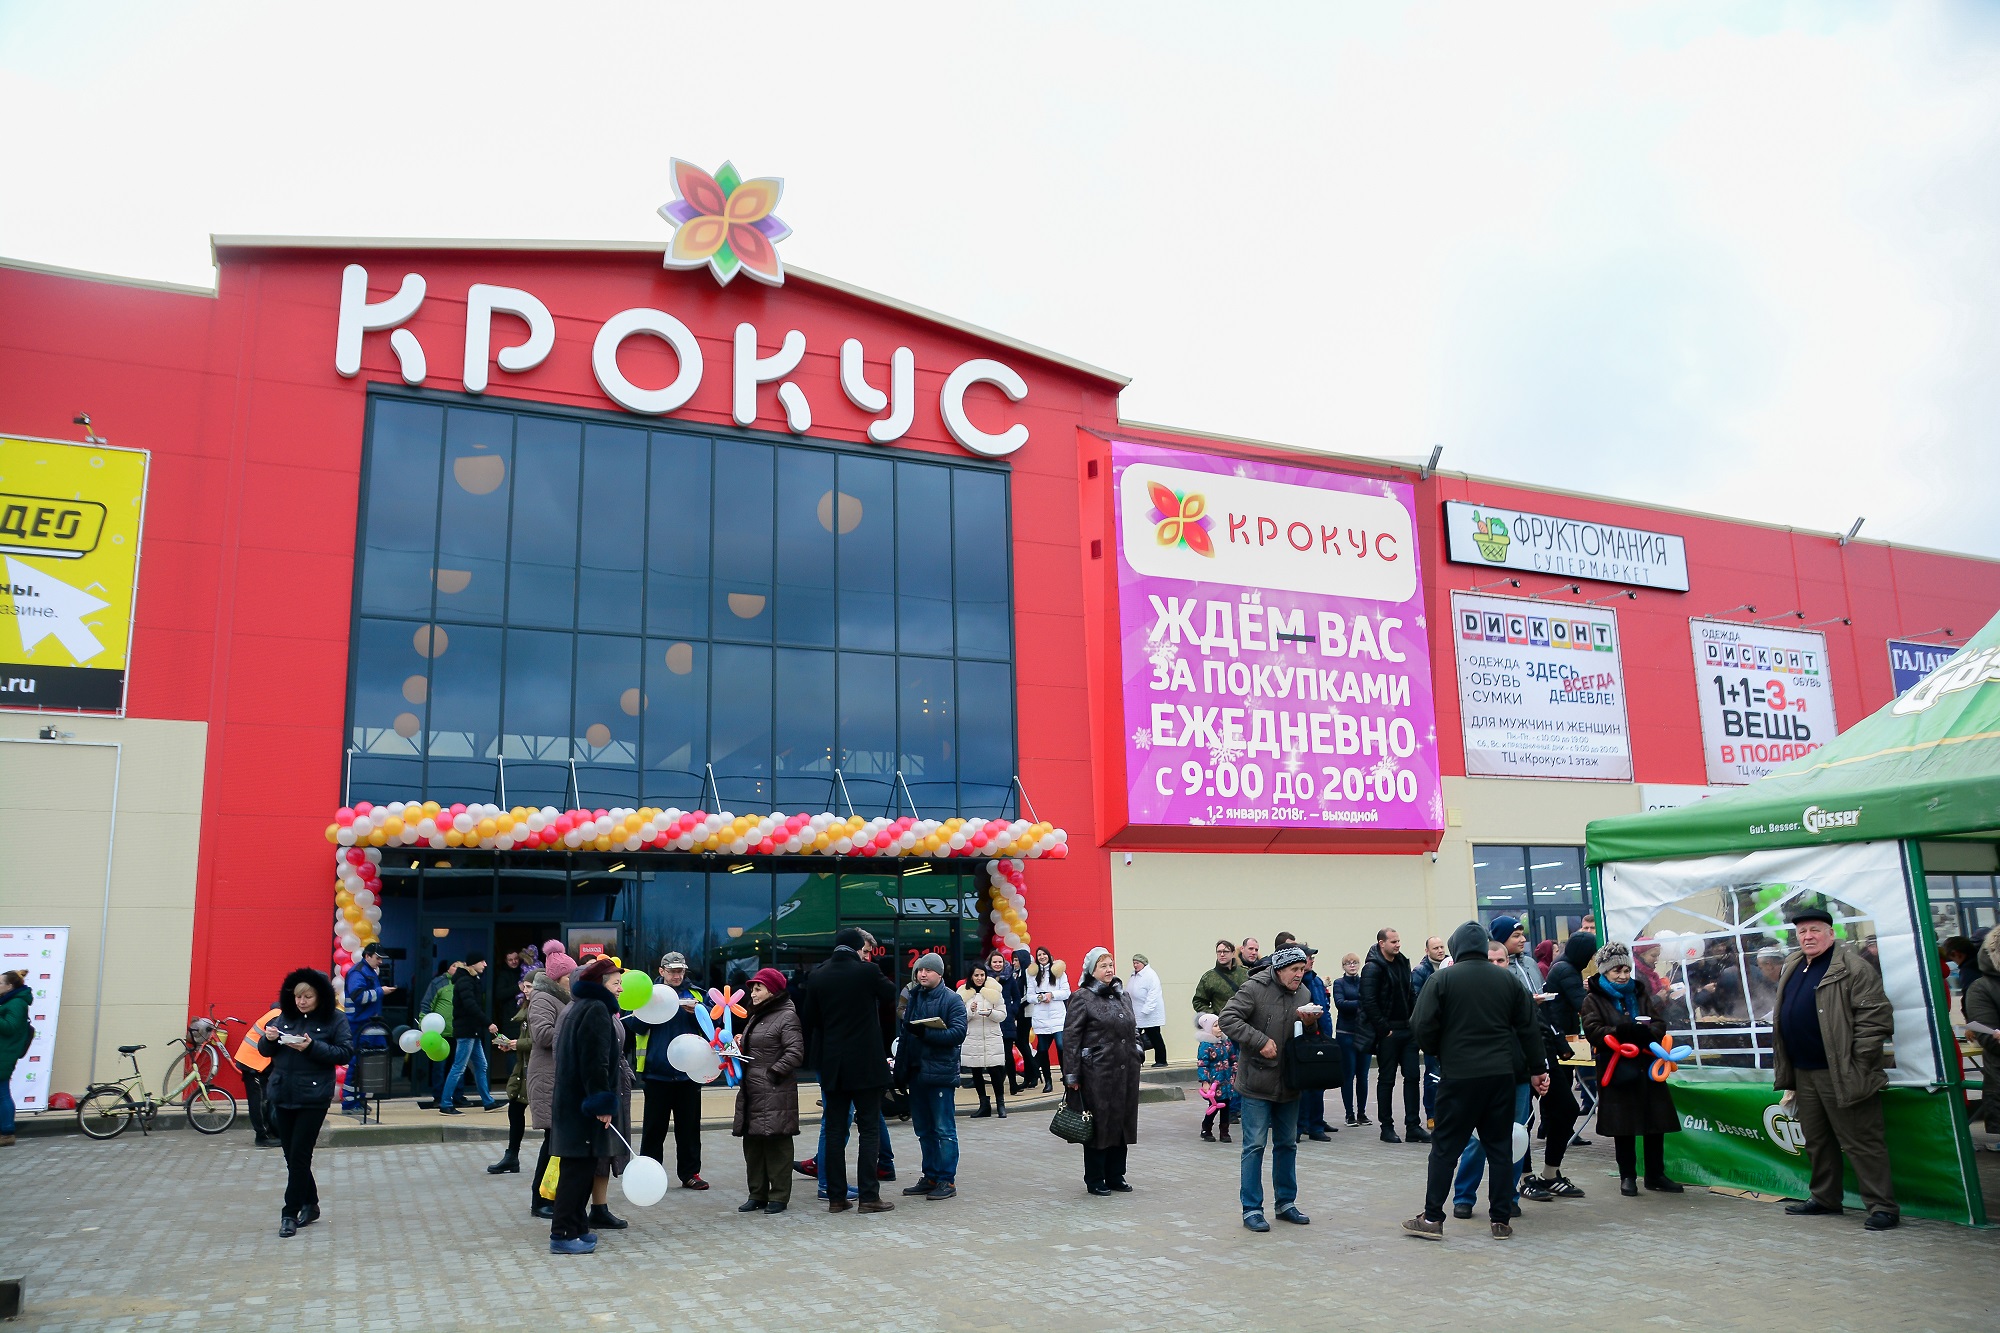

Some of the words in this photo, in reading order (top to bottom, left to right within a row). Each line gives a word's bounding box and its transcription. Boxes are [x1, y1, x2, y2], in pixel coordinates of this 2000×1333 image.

[335, 264, 1029, 457] КРОКУС
[1229, 513, 1398, 561] КРОКУС
[1513, 514, 1667, 566] ФРУКТОМАНИЯ
[1534, 552, 1650, 584] СУПЕРМАРКЕТ
[1148, 592, 1307, 657] ЖДЁМ
[1318, 611, 1406, 663] ВАС
[1702, 629, 1741, 641] ОДЕЖДА
[1469, 655, 1520, 671] ОДЕЖДА
[1892, 649, 1952, 672] ГАЛАН
[1149, 656, 1196, 693] ЗА
[1203, 660, 1410, 706] ПОКУПКАМИ
[1471, 672, 1521, 688] ОБУВЬ
[1525, 662, 1580, 682] ЗДЕСЬ
[1563, 672, 1615, 693] ВСЕГДА
[1792, 677, 1822, 688] ОБУВЬ
[0, 675, 36, 693] .ru
[1472, 690, 1522, 705] СУМКИ
[1550, 690, 1615, 705] ДЕШЕВЛЕ!
[1151, 703, 1415, 758] ЕЖЕДНЕВНО
[1471, 715, 1496, 729] ДЛЯ
[1499, 717, 1553, 732] МУЖЧИН
[1556, 720, 1564, 732] И
[1567, 721, 1621, 736] ЖЕНЩИН
[1723, 709, 1811, 741] ВЕЩЬ
[1501, 752, 1517, 765] ТЦ
[1568, 755, 1574, 766] 1
[1575, 757, 1599, 767] этаж
[1721, 745, 1736, 763] В
[1156, 768, 1174, 797] с
[1181, 761, 1264, 798] 9:00
[1273, 772, 1315, 804] до
[1322, 767, 1418, 803] 20:00
[1226, 807, 1269, 822] января
[1271, 807, 1307, 821] 2018г.
[1322, 808, 1378, 823] выходной
[1749, 825, 1766, 835] Gut.
[1769, 822, 1800, 833] Besser.
[1802, 805, 1861, 835] Gösser
[1684, 1114, 1713, 1132] Gut.
[1715, 1120, 1765, 1141] Besser.
